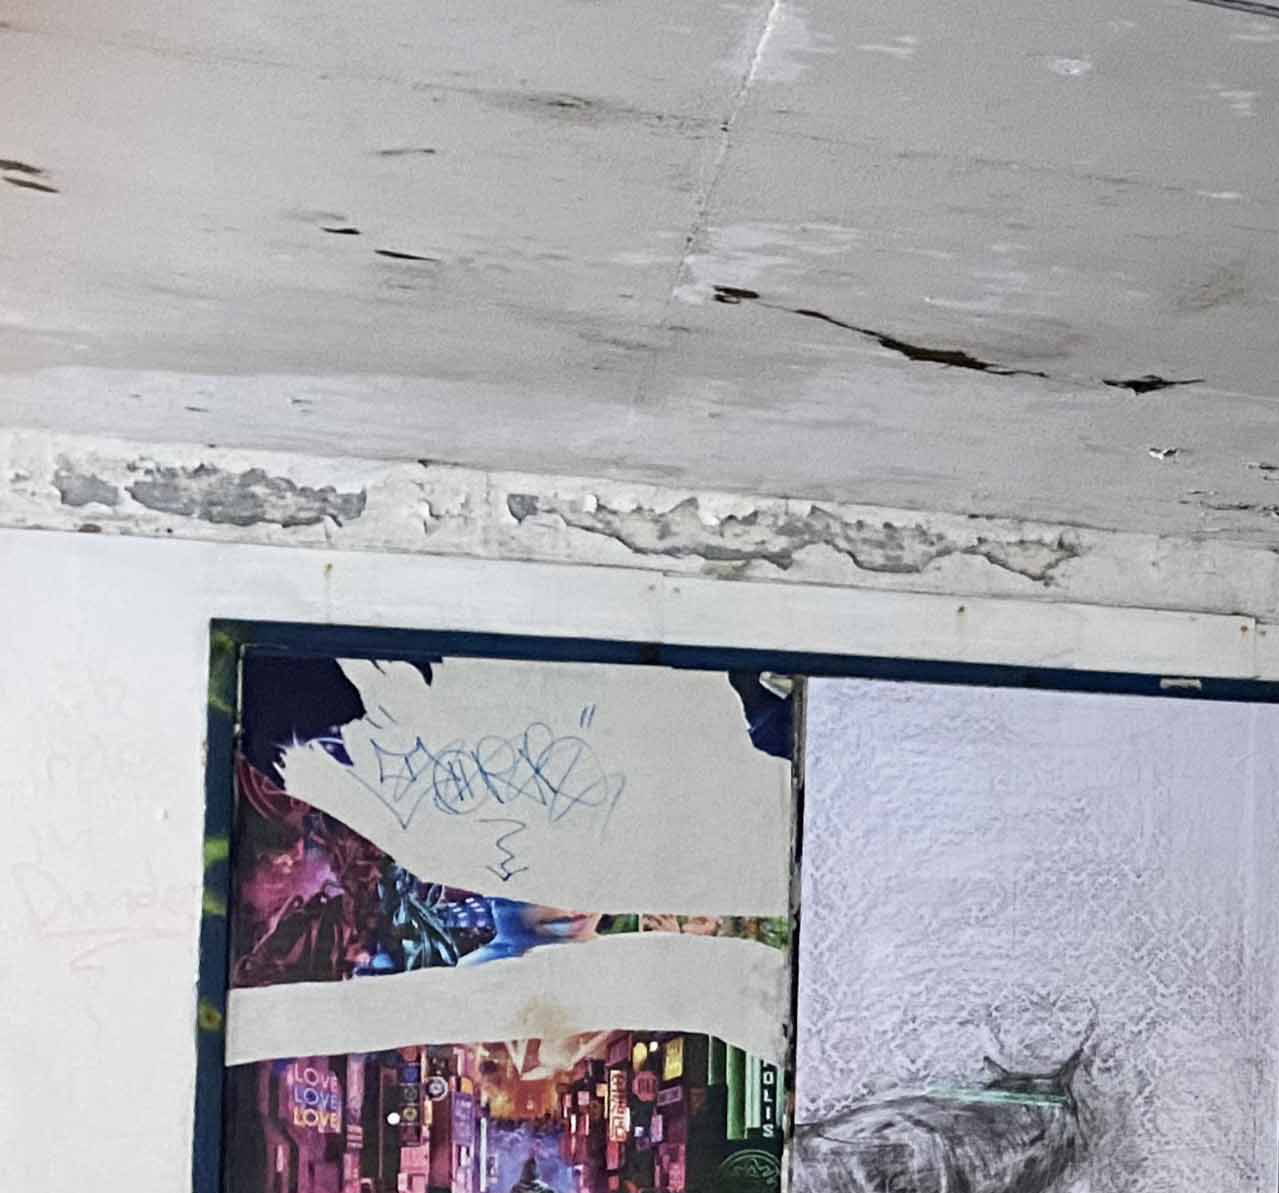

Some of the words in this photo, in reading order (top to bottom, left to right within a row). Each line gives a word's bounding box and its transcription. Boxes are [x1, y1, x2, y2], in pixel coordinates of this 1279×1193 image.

[294, 1065, 338, 1093] LOVE
[294, 1086, 338, 1111] LOVE
[293, 1106, 338, 1128] LOVE
